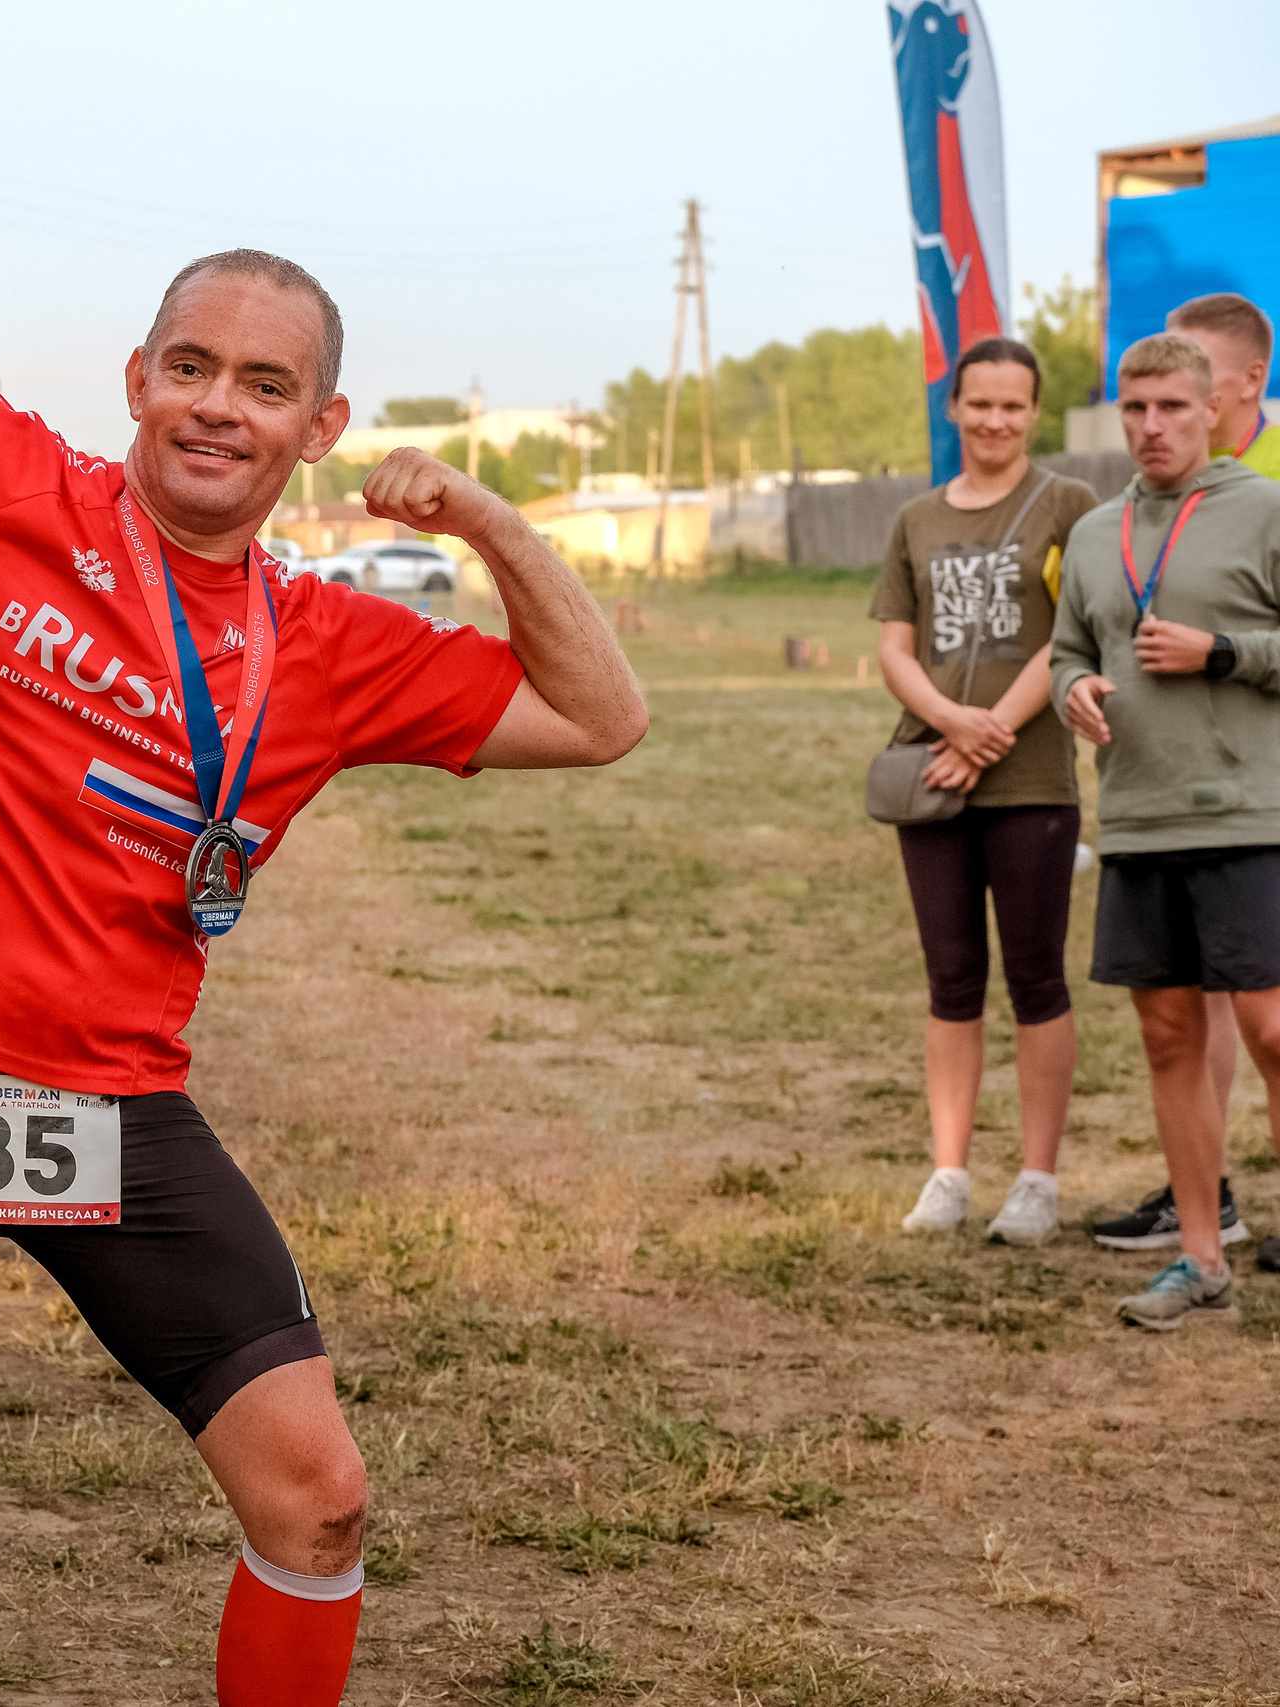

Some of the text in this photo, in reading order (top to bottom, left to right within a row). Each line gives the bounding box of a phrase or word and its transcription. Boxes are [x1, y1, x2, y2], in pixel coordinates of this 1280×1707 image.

[123, 513, 147, 553] august
[138, 554, 159, 587] 2022
[245, 612, 265, 708] #SIBERMAN515
[0, 664, 75, 712] RUSSIAN
[80, 706, 162, 755] BUSINESS
[201, 911, 234, 921] SIBERMAN
[11, 1101, 61, 1109] TRIATHLON
[31, 1209, 101, 1220] ВЯЧЕСЛАВ
